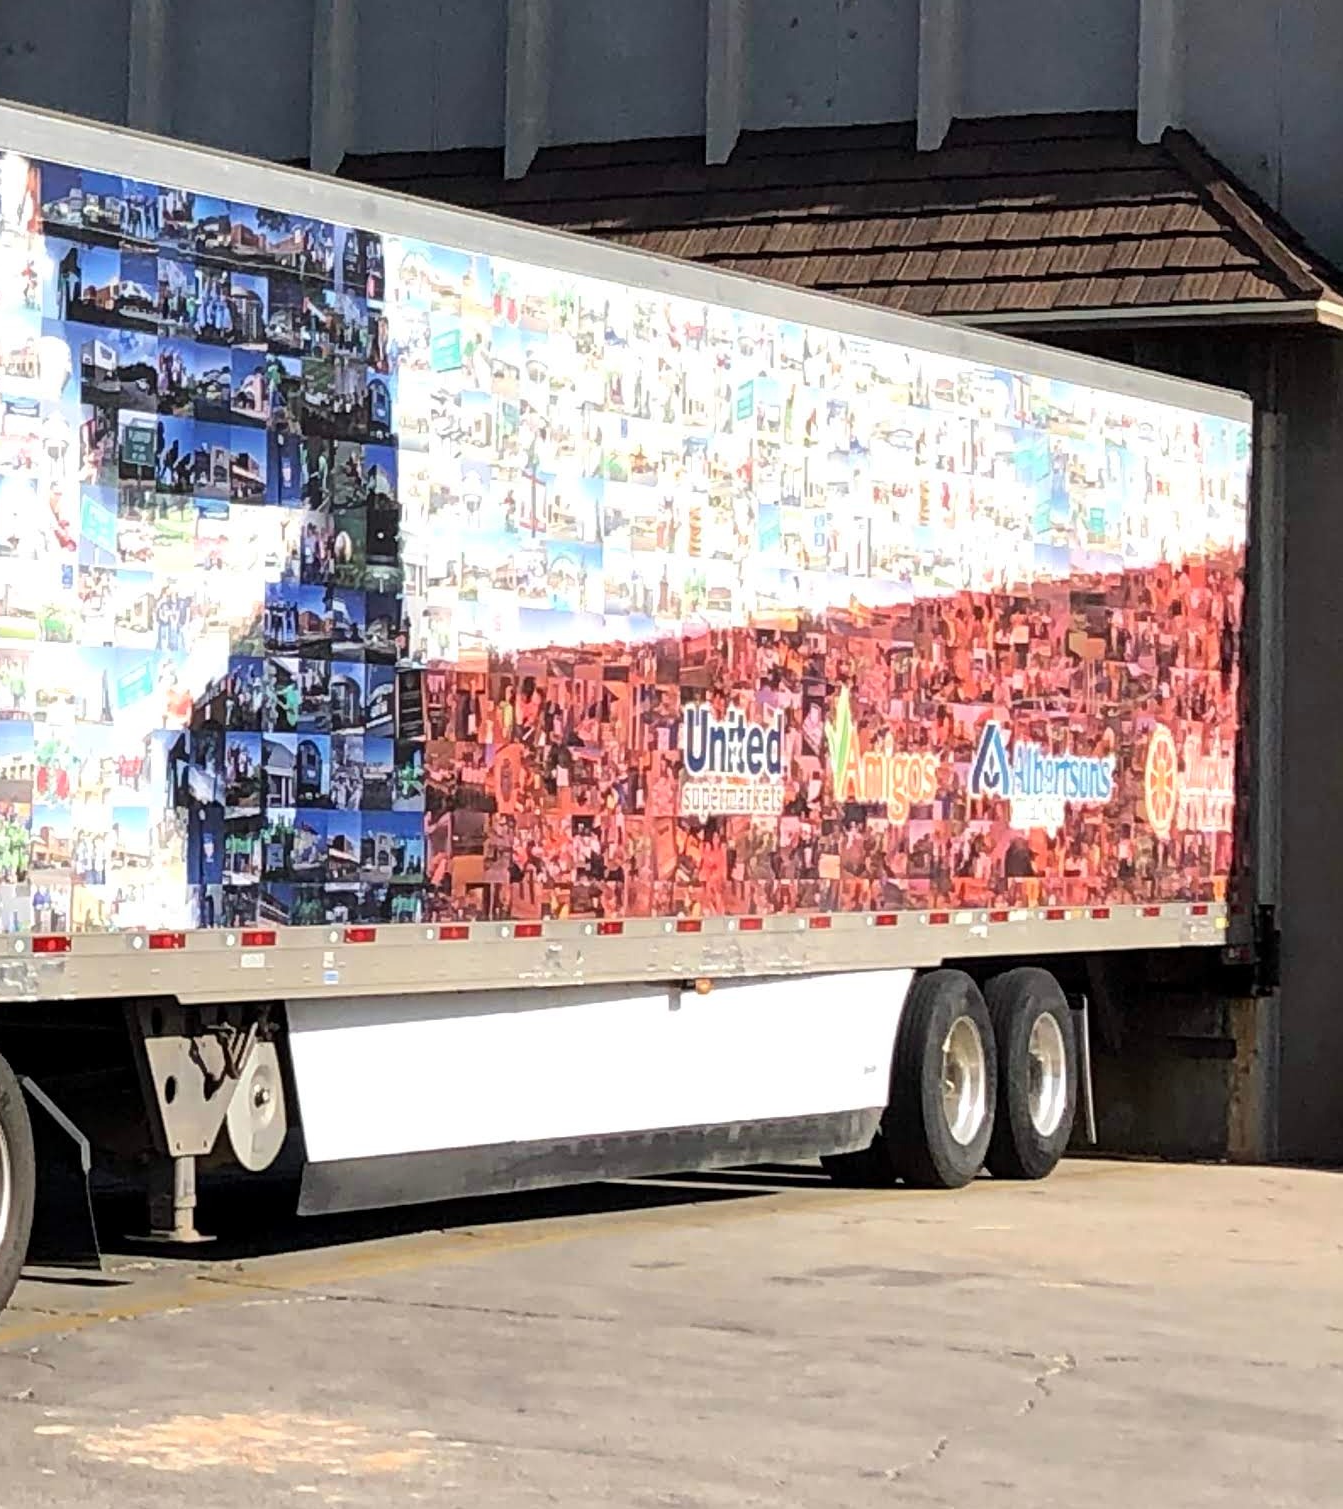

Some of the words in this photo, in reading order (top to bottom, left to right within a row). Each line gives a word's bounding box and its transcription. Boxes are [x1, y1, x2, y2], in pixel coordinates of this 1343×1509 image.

[685, 708, 783, 776] United
[1013, 743, 1112, 799] Albertsons
[681, 785, 784, 823] supermarkets
[843, 733, 938, 823] Amigos
